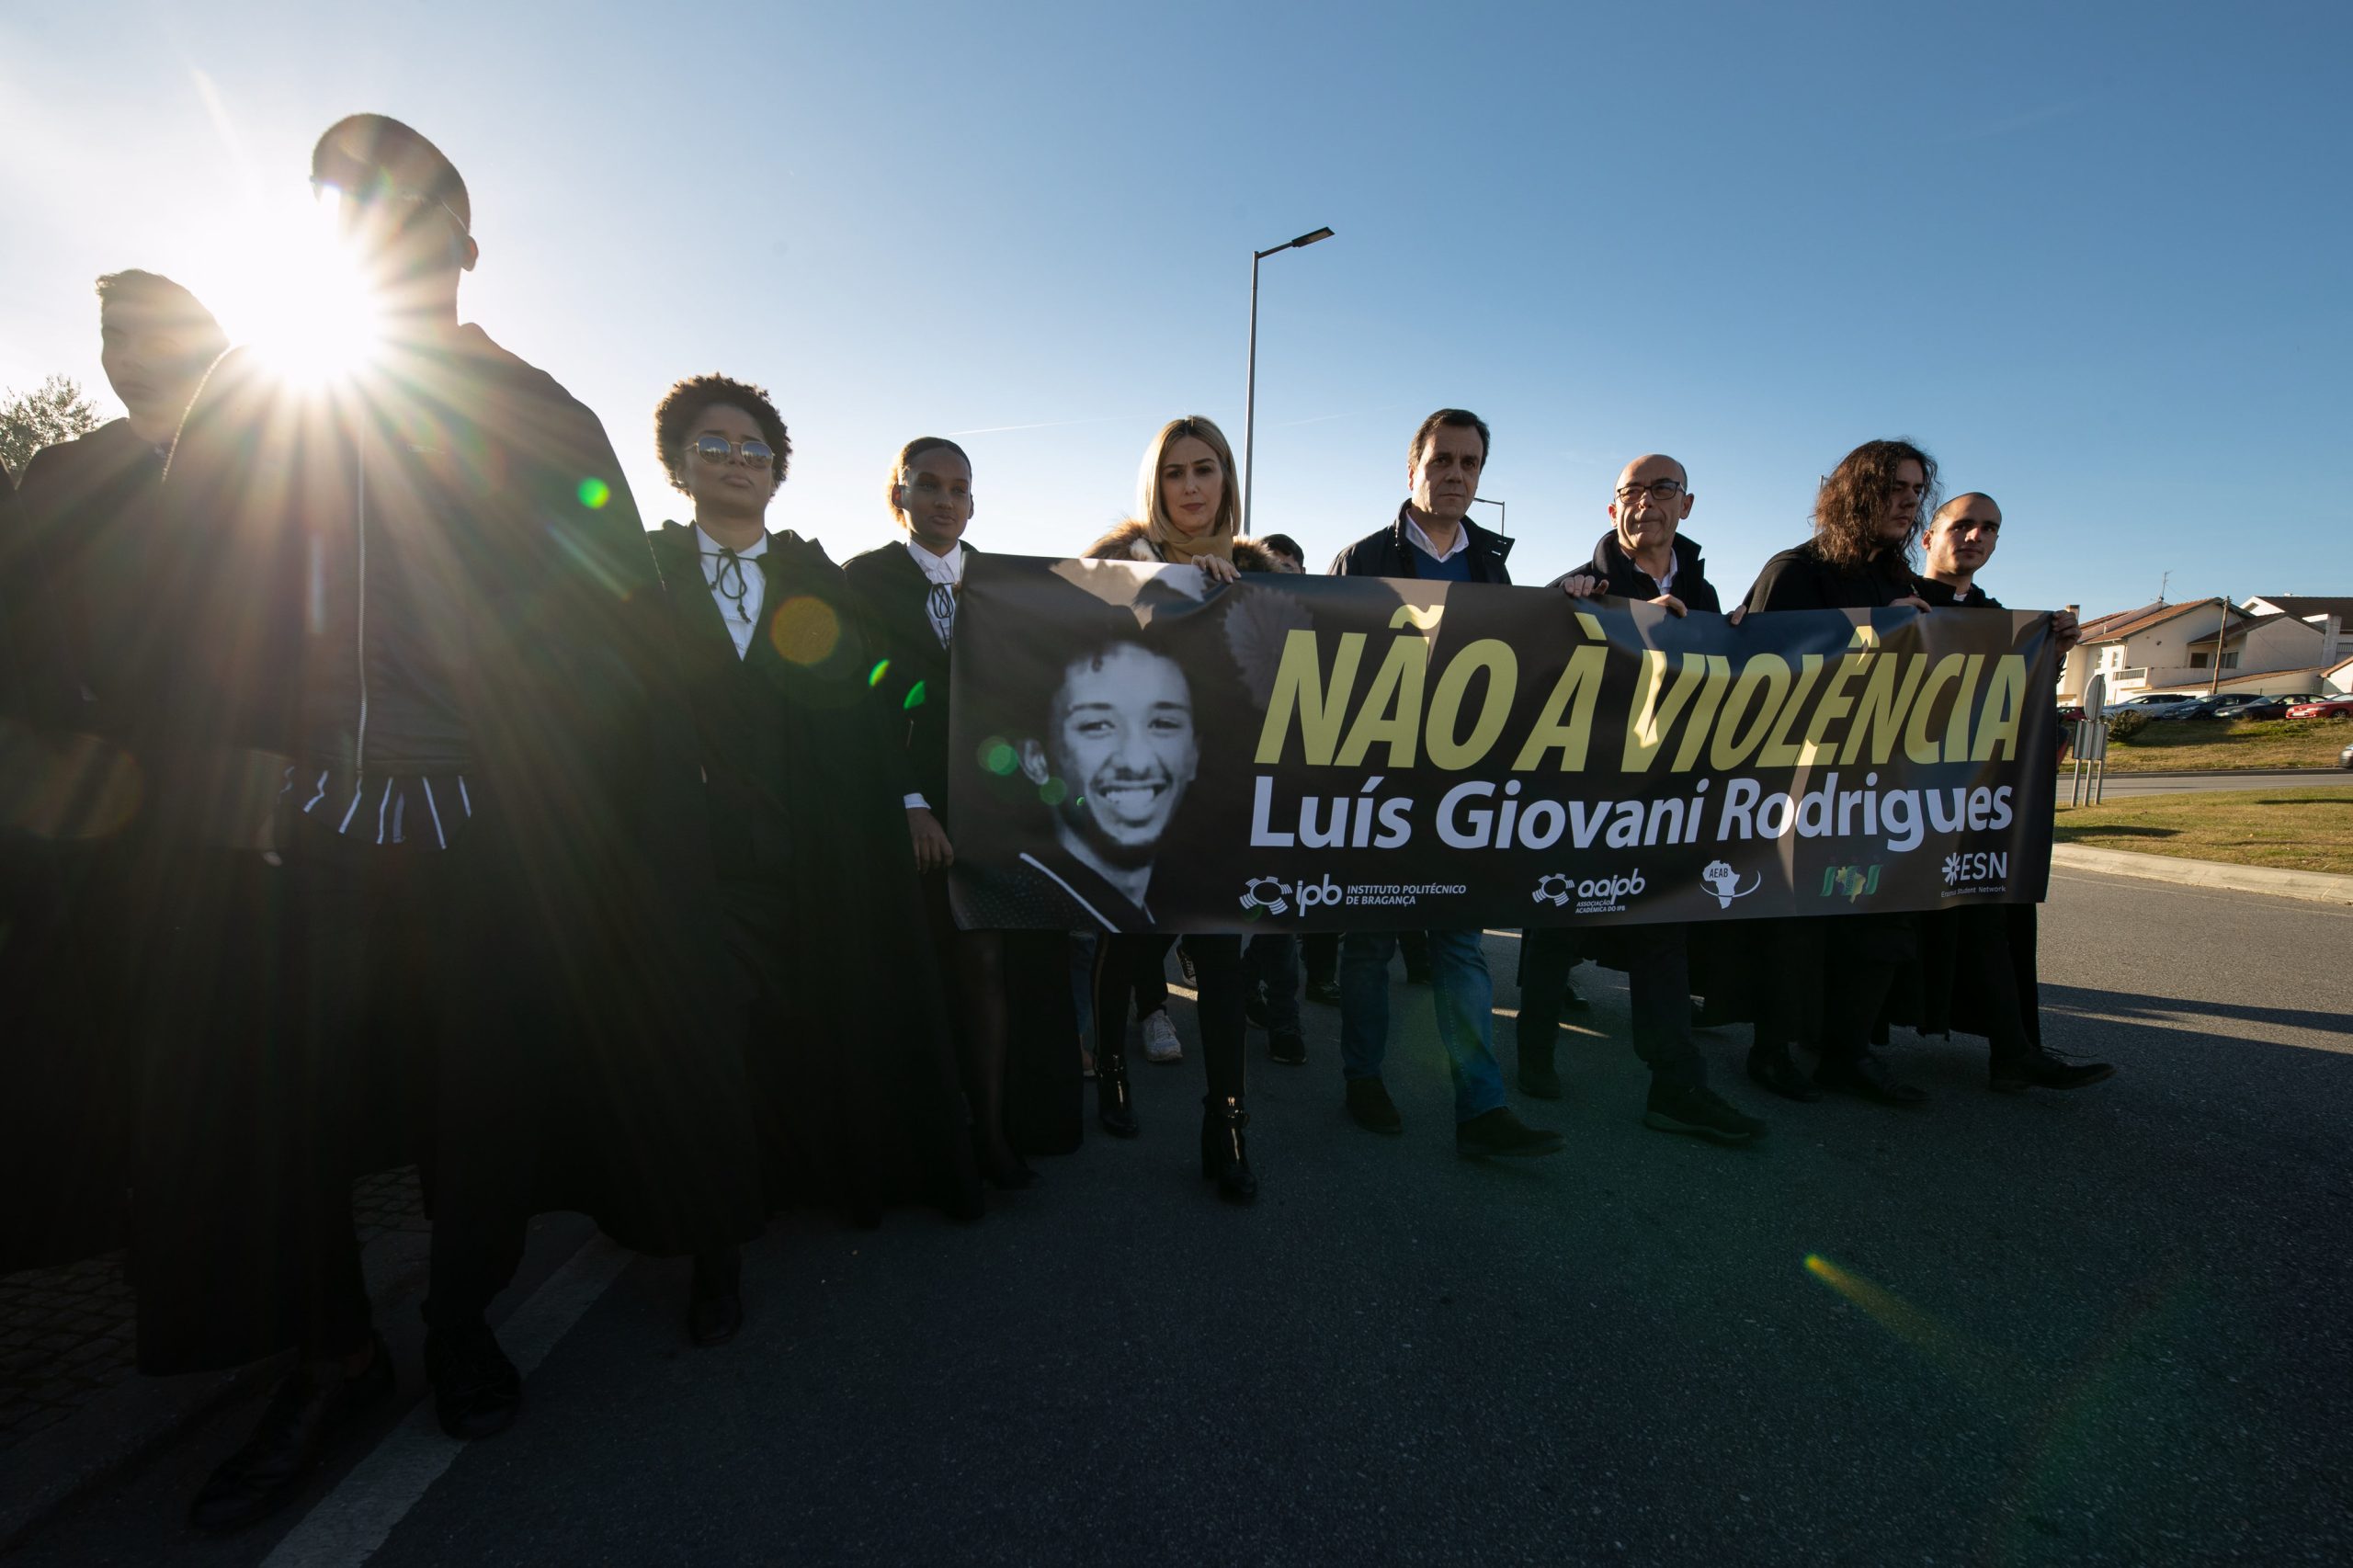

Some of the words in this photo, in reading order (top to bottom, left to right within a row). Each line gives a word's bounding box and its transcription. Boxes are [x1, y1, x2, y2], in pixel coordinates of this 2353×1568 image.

[1253, 604, 1518, 771] NÃO
[1510, 611, 1608, 772] À
[1620, 625, 2027, 773] VIOLÊNCIA
[1250, 775, 1414, 849] Luís
[1436, 778, 1710, 850] Giovani
[1716, 772, 2013, 852] Rodrigues
[1709, 868, 1729, 879] AEAB
[1960, 851, 2007, 881] ESN
[1295, 873, 1343, 917] ipb
[1346, 895, 1359, 905] DE
[1361, 895, 1416, 907] BRAGANÇA
[1347, 884, 1401, 894] INSTITUTO
[1402, 882, 1467, 894] POLITÉCNICO
[1577, 868, 1646, 905] aaipb
[1978, 885, 2006, 893] Network
